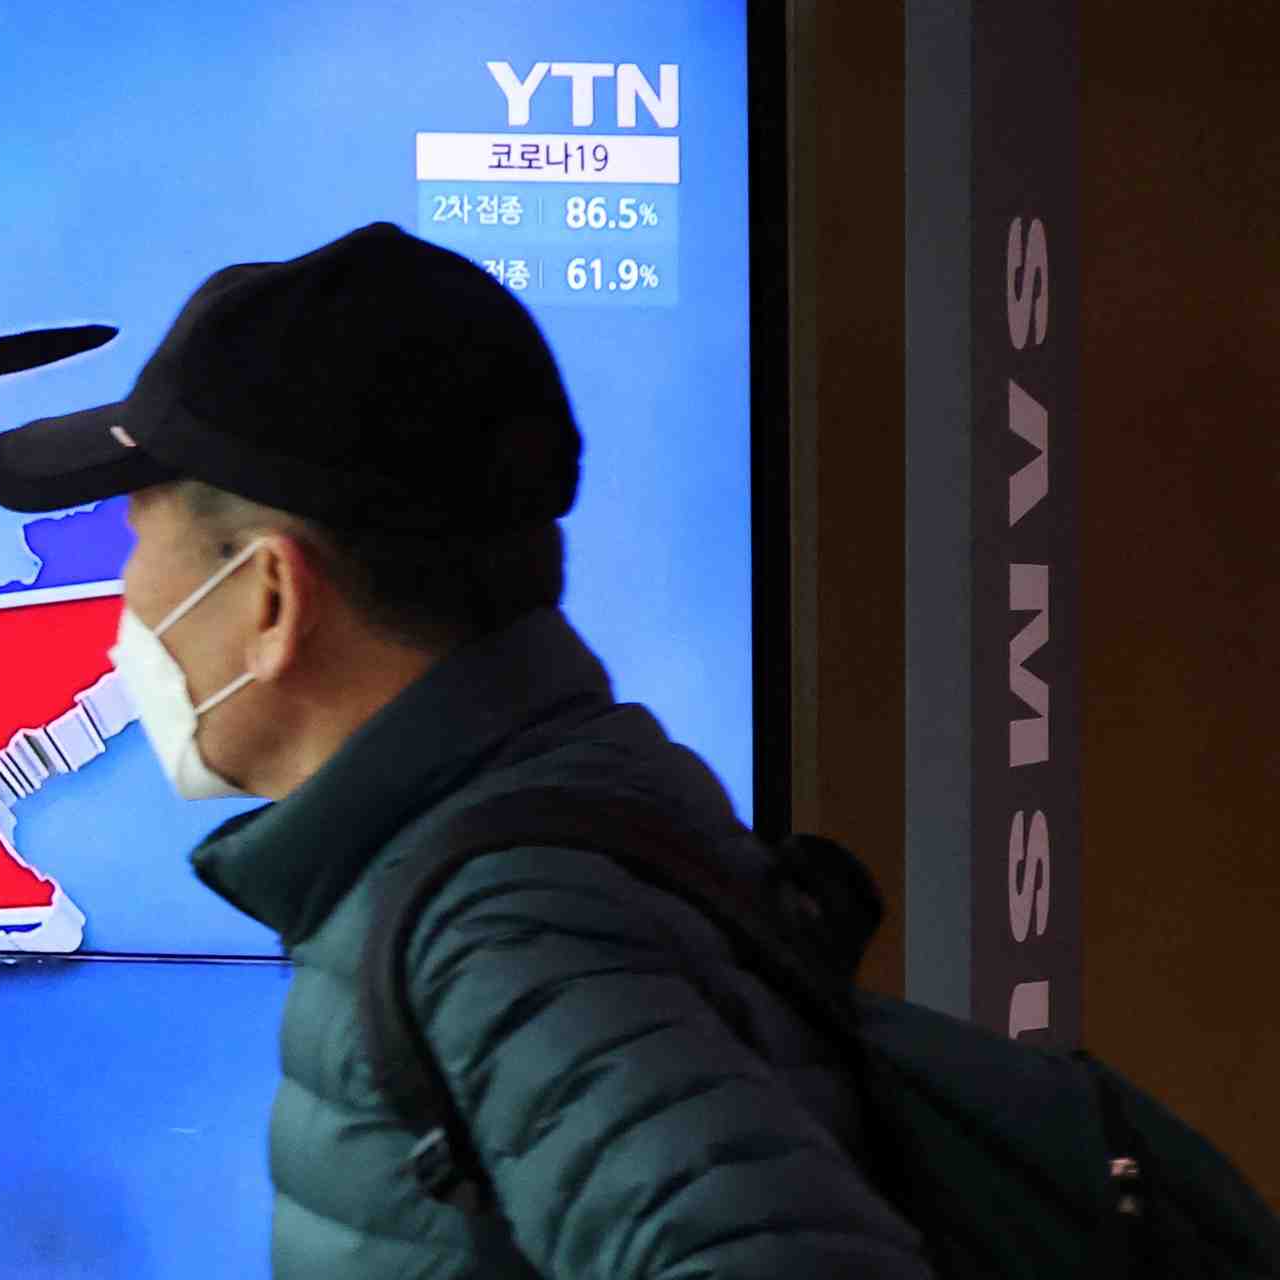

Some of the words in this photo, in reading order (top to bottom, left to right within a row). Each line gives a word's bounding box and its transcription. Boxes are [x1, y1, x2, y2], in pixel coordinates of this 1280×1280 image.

[487, 62, 679, 128] YTN
[489, 143, 608, 173] 코로나19
[566, 196, 658, 229] 86.5%
[567, 258, 659, 290] 61.9%
